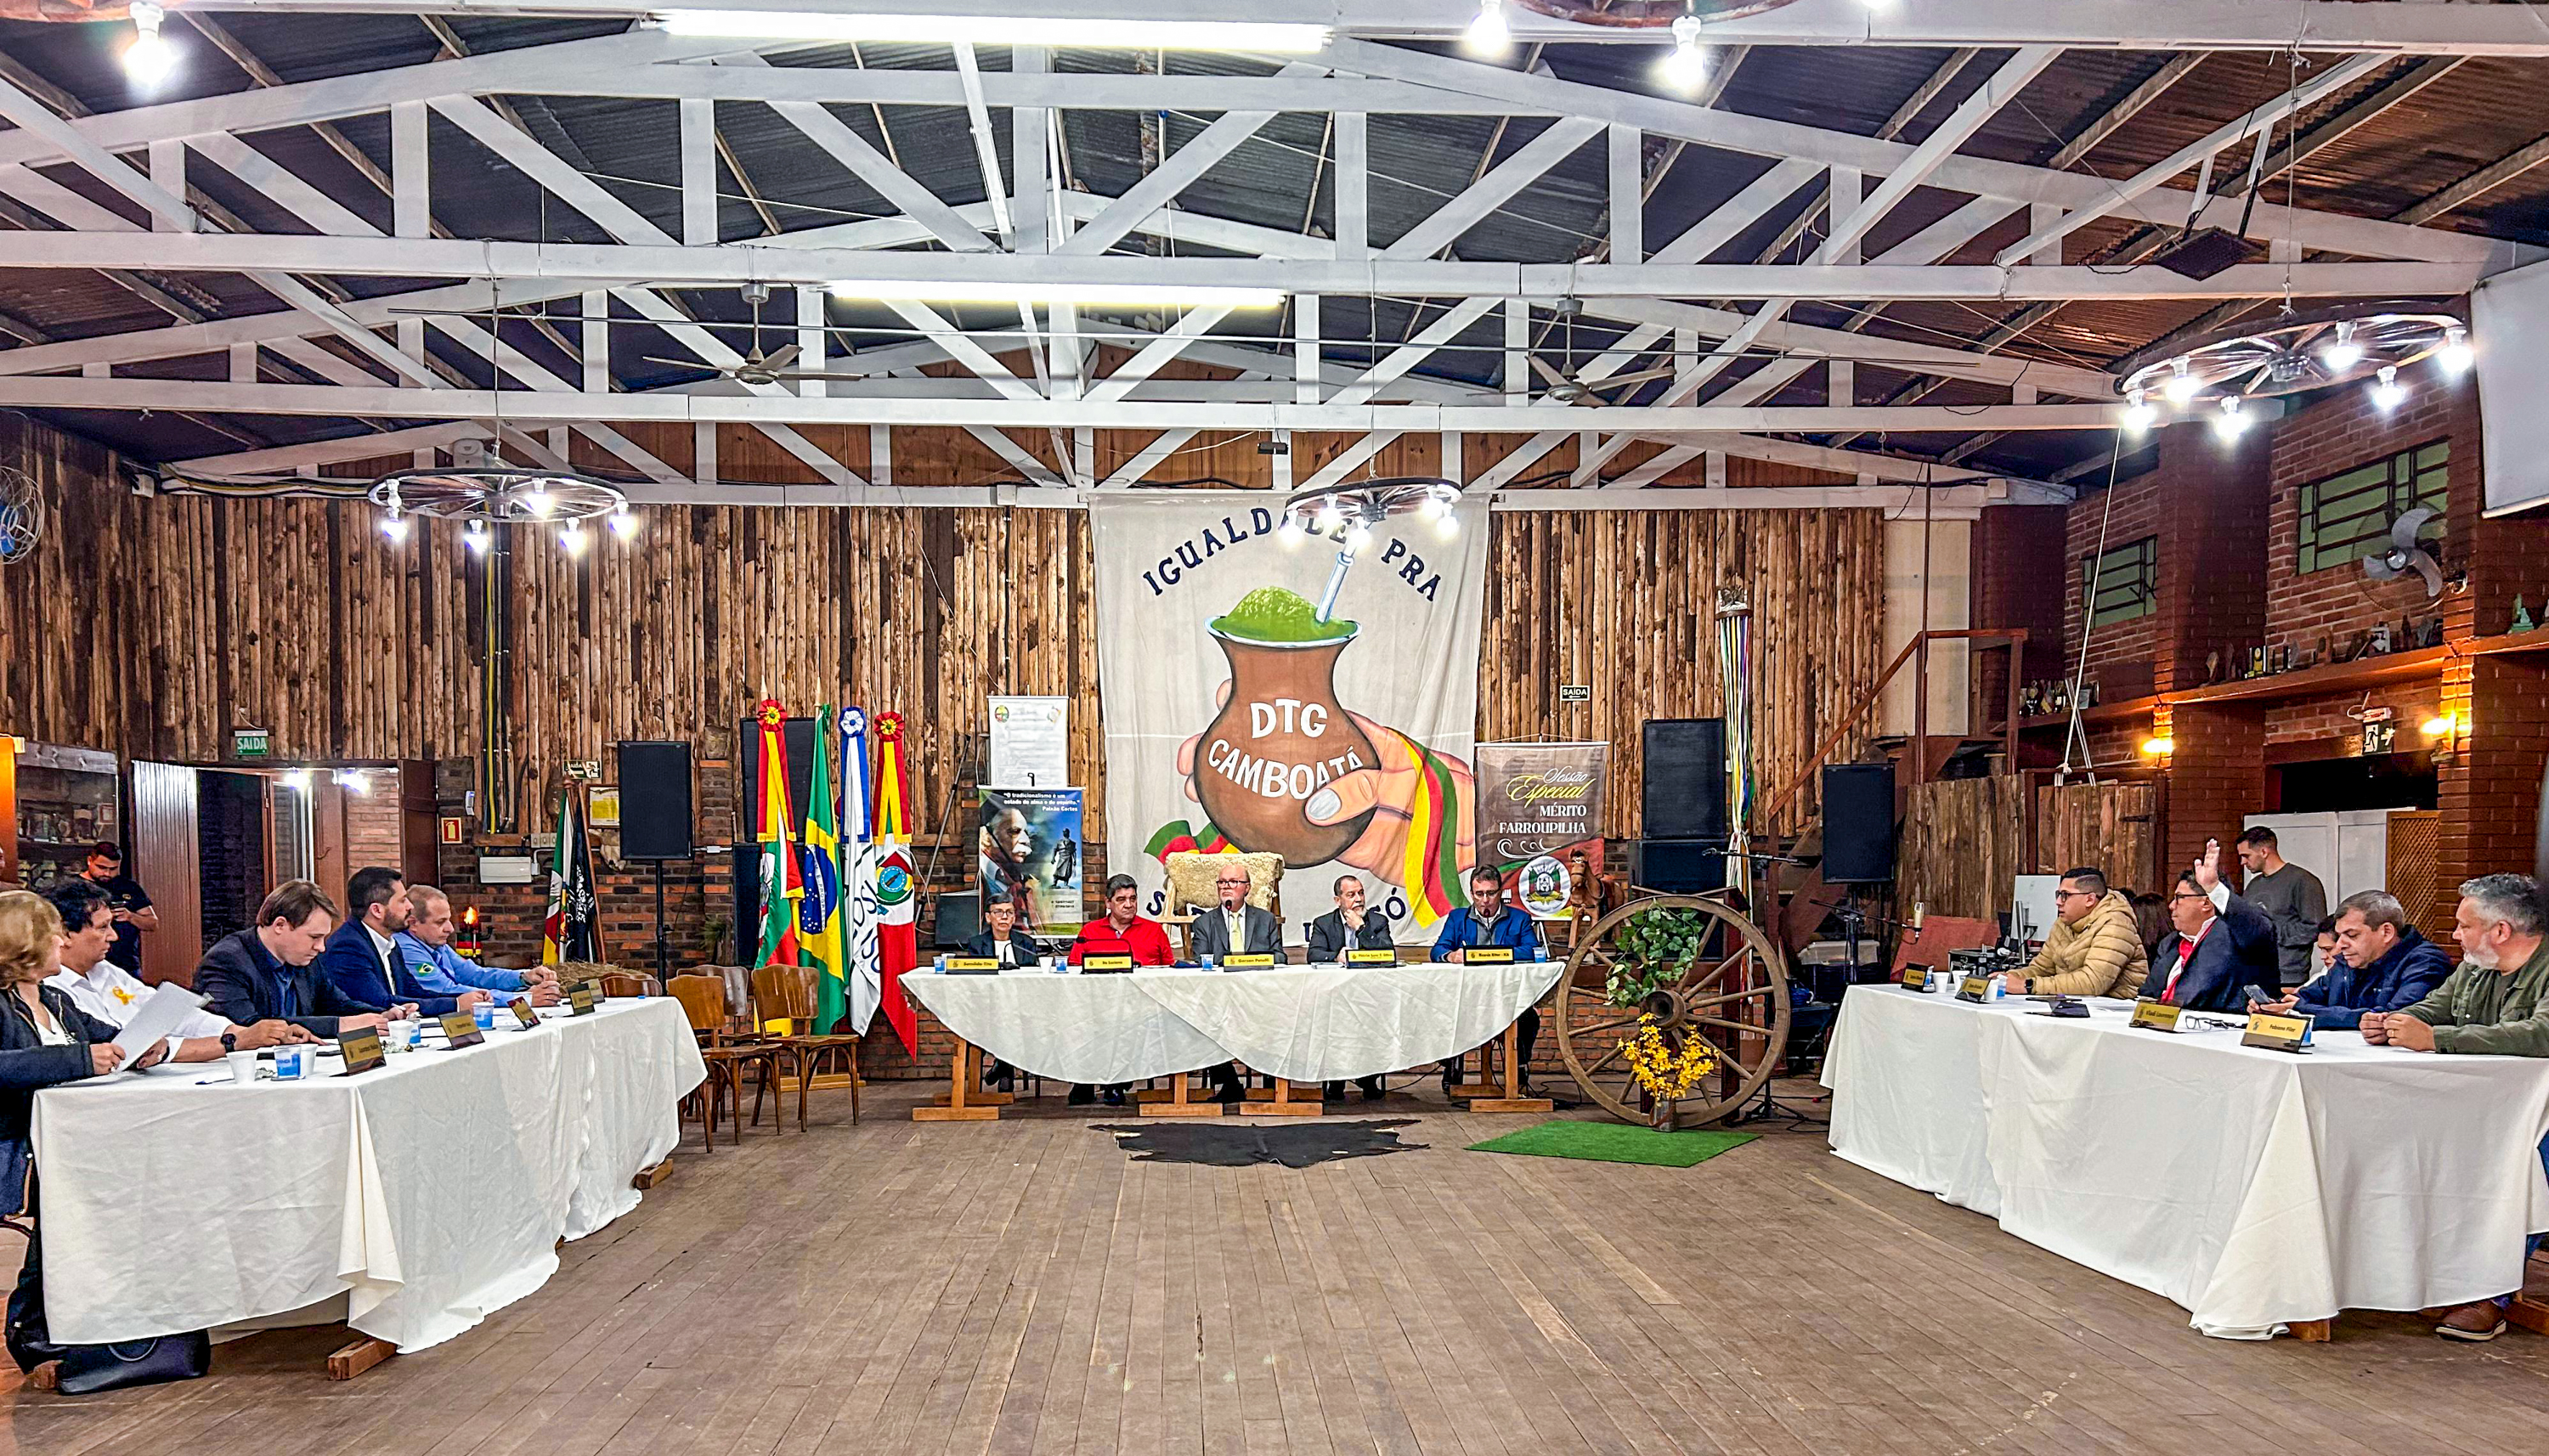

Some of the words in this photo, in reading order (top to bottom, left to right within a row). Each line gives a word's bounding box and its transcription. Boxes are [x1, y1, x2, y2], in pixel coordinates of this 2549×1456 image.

[1143, 507, 1353, 596] IGUALDE
[1380, 537, 1442, 602] PRA
[1563, 687, 1587, 696] SAÍDA
[1249, 697, 1328, 739] DTG
[1207, 738, 1364, 800] CAMBOATÁ
[1543, 765, 1589, 784] Sessão
[1506, 775, 1597, 808] Especial
[1539, 802, 1587, 817] MÉRITO
[1499, 821, 1586, 834] FARROUPILHA
